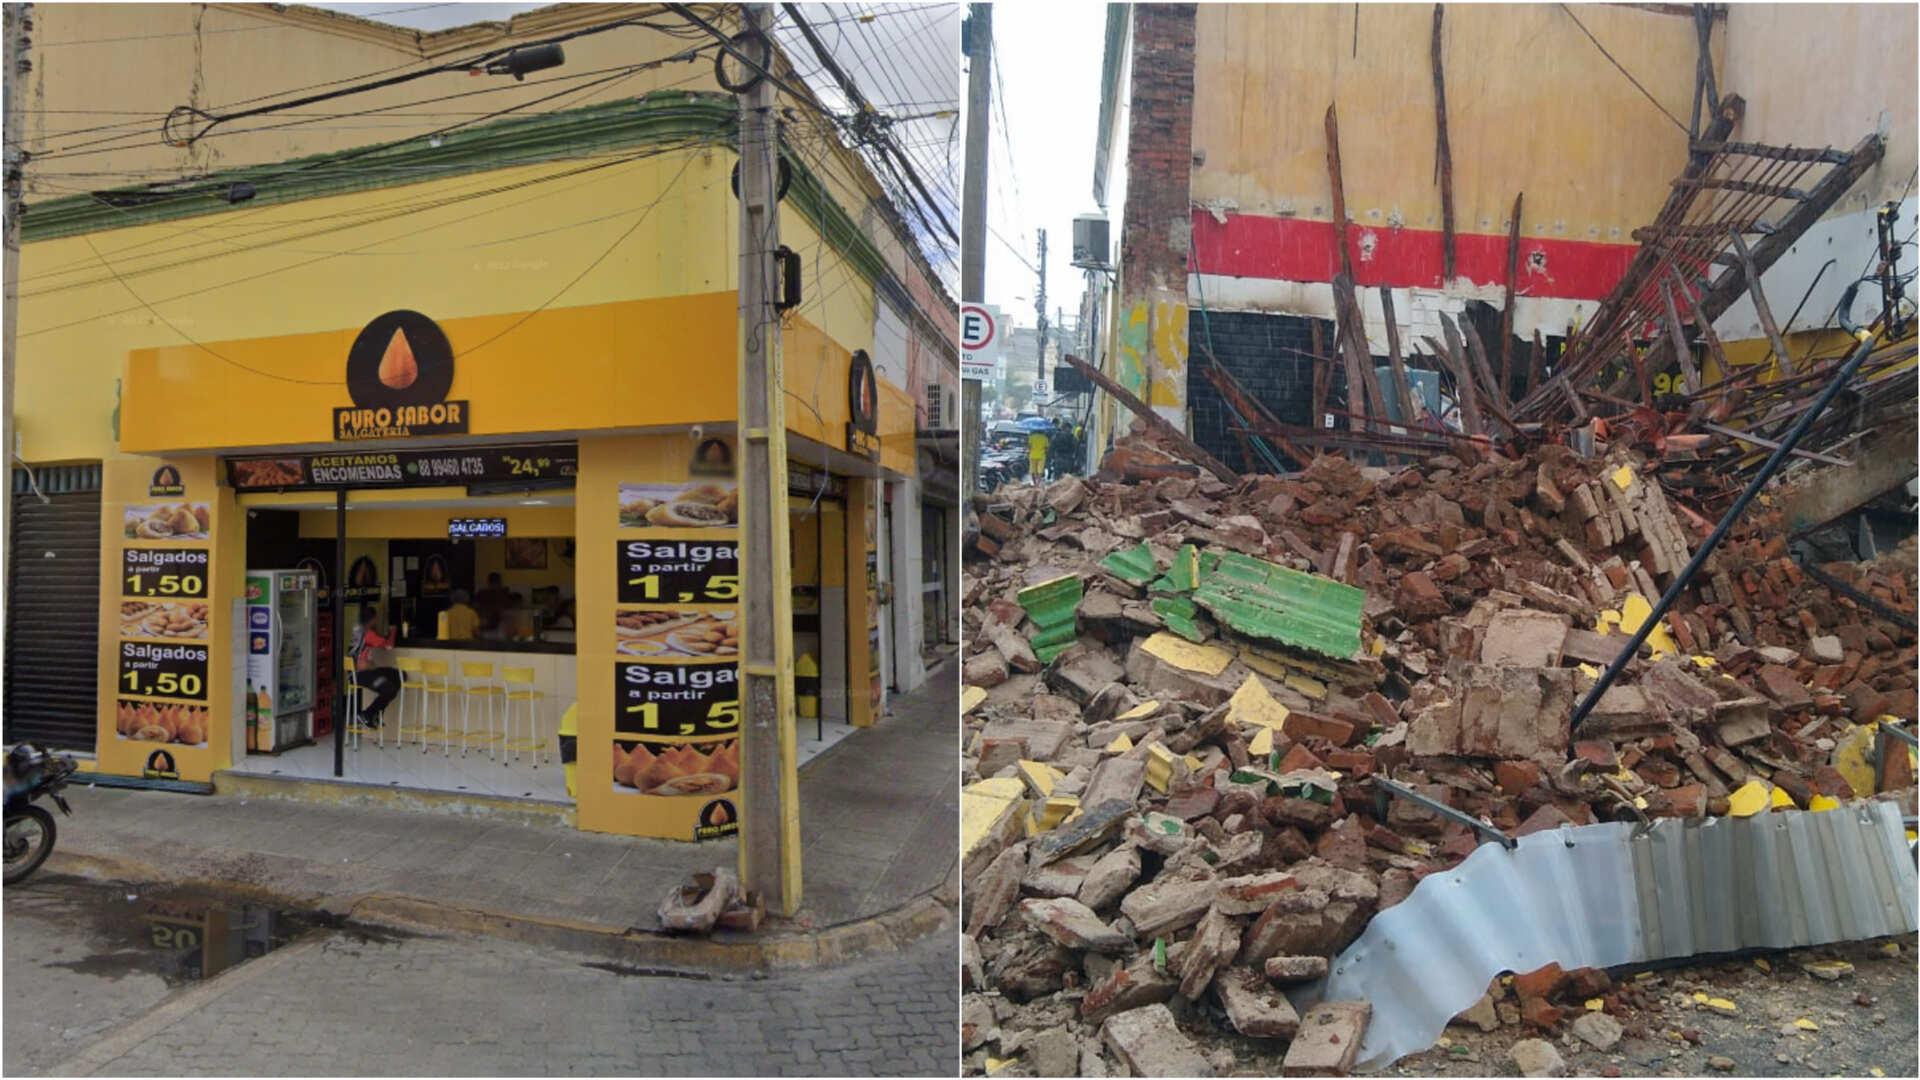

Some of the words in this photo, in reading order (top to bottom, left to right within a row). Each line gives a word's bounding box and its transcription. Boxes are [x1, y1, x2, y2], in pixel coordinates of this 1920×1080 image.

[964, 316, 980, 340] E
[339, 407, 392, 429] PURO
[396, 403, 460, 426] SABOR
[312, 454, 398, 468] ACEITAMOS
[312, 465, 403, 484] ENCOMENDAS
[127, 550, 207, 566] Salgados
[135, 566, 160, 574] partir
[630, 564, 642, 572] a
[649, 563, 705, 573] partir
[127, 574, 203, 596] 1,50
[123, 642, 207, 661] Salgados
[132, 661, 159, 669] partir
[123, 670, 202, 696] 1,50
[628, 689, 641, 698] a
[647, 690, 706, 701] partir
